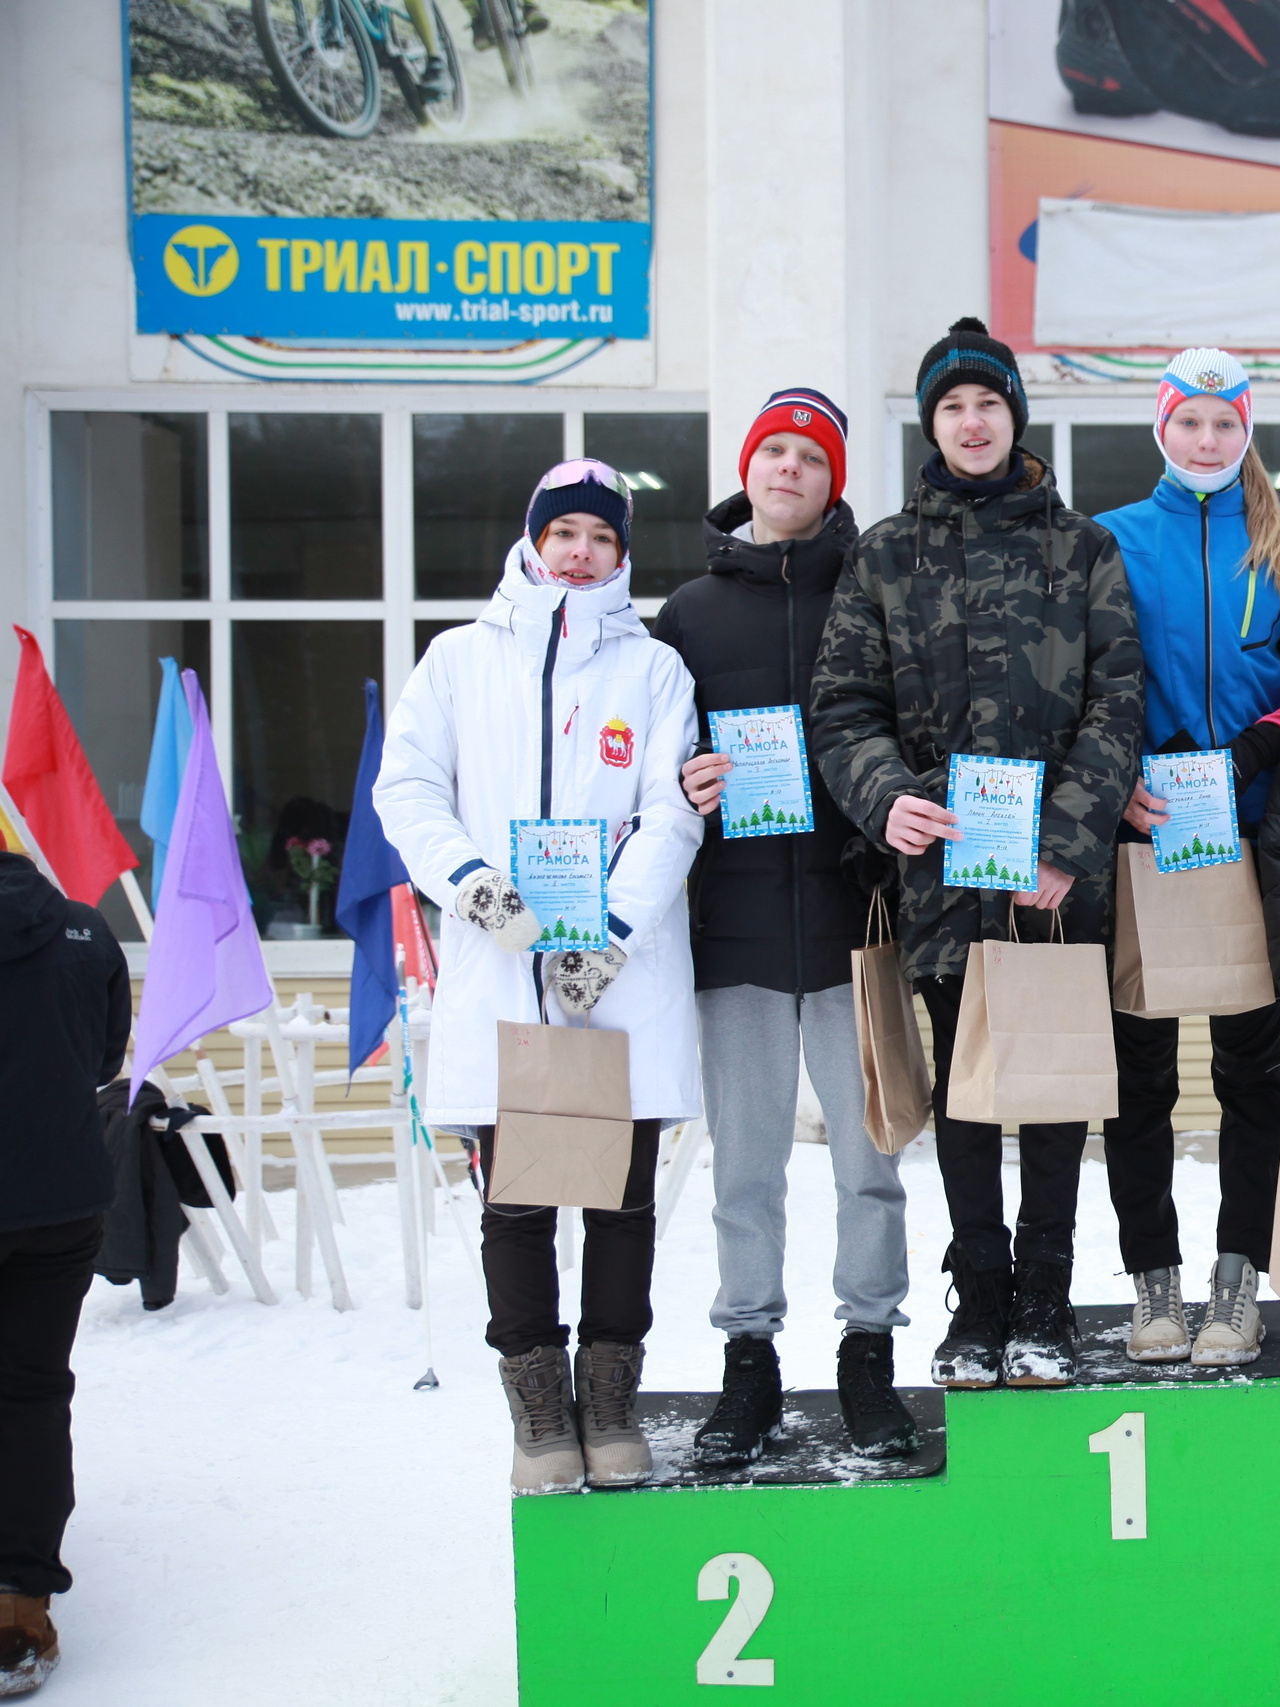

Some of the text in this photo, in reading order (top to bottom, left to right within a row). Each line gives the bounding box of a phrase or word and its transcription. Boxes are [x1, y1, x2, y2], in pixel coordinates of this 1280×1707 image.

[394, 299, 613, 326] www.trial-sport.ru
[730, 740, 788, 754] ГРАМОТА
[1161, 777, 1217, 791] ГРАМОТА
[964, 791, 1023, 806] ГРАМОТА
[528, 855, 589, 865] ГРАМОТА
[1088, 1411, 1147, 1540] 1
[696, 1553, 775, 1687] 2
